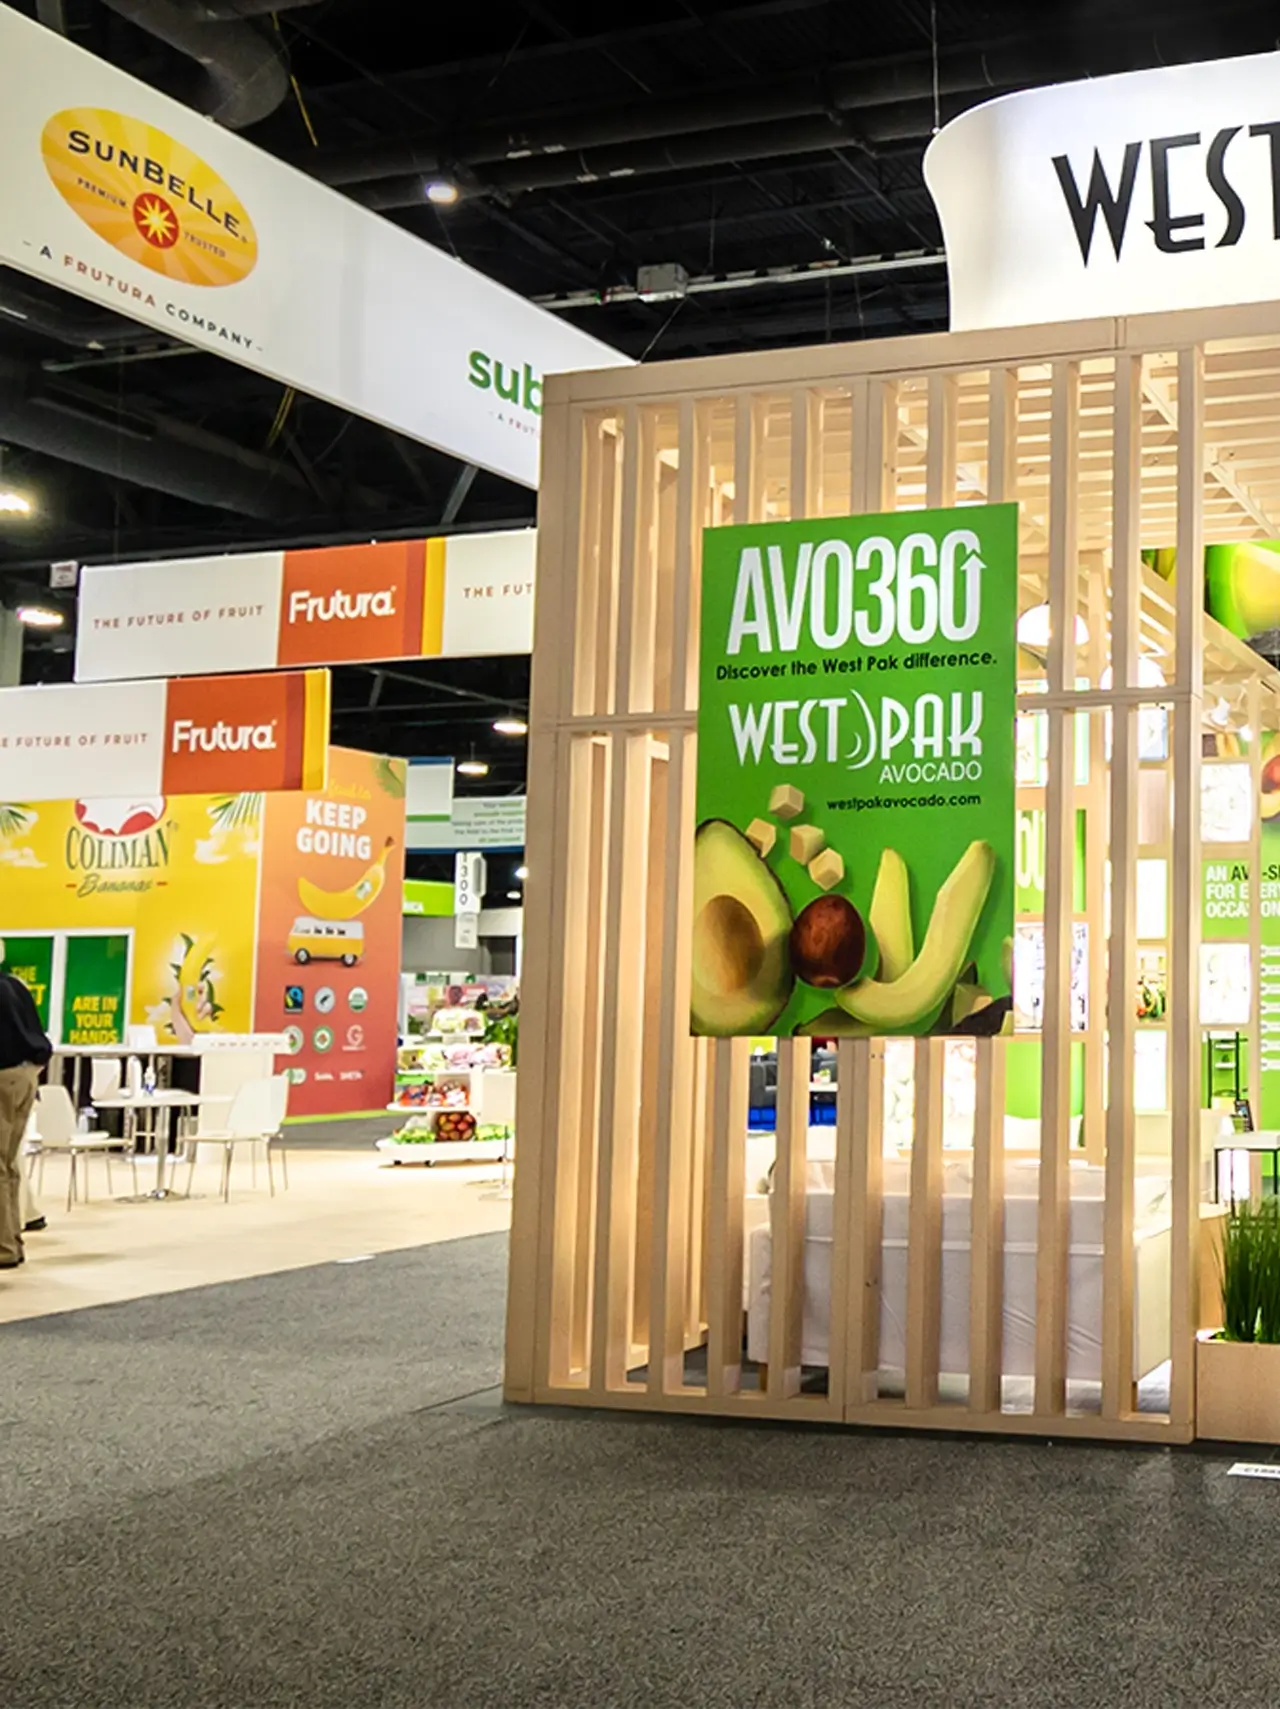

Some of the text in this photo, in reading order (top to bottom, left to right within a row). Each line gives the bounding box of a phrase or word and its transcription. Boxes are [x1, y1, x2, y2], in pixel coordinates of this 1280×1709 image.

[77, 176, 127, 208] PREMIUM
[183, 231, 226, 258] TRUSTED
[40, 245, 253, 349] A FRUTURA COMPANY
[463, 586, 494, 599] THE
[726, 528, 988, 656] AVO360
[93, 604, 264, 630] THE FUTURE OF FRUIT
[715, 650, 998, 681] Discover the West Pak difference.
[15, 736, 71, 748] FUTURE
[78, 734, 97, 746] OF
[104, 732, 149, 745] FRUIT
[728, 690, 983, 767] WEST PAK
[878, 760, 983, 785] AVOCADO
[305, 798, 367, 831] KEEP
[826, 793, 982, 813] westpakavocado.com
[65, 825, 169, 870] COLIMAN
[295, 826, 372, 861] GOING
[1205, 864, 1228, 882] AN
[1205, 883, 1236, 900] FOR
[72, 995, 118, 1012] ARE IN
[75, 1012, 114, 1029] YOUR
[69, 1029, 119, 1045] HANDS
